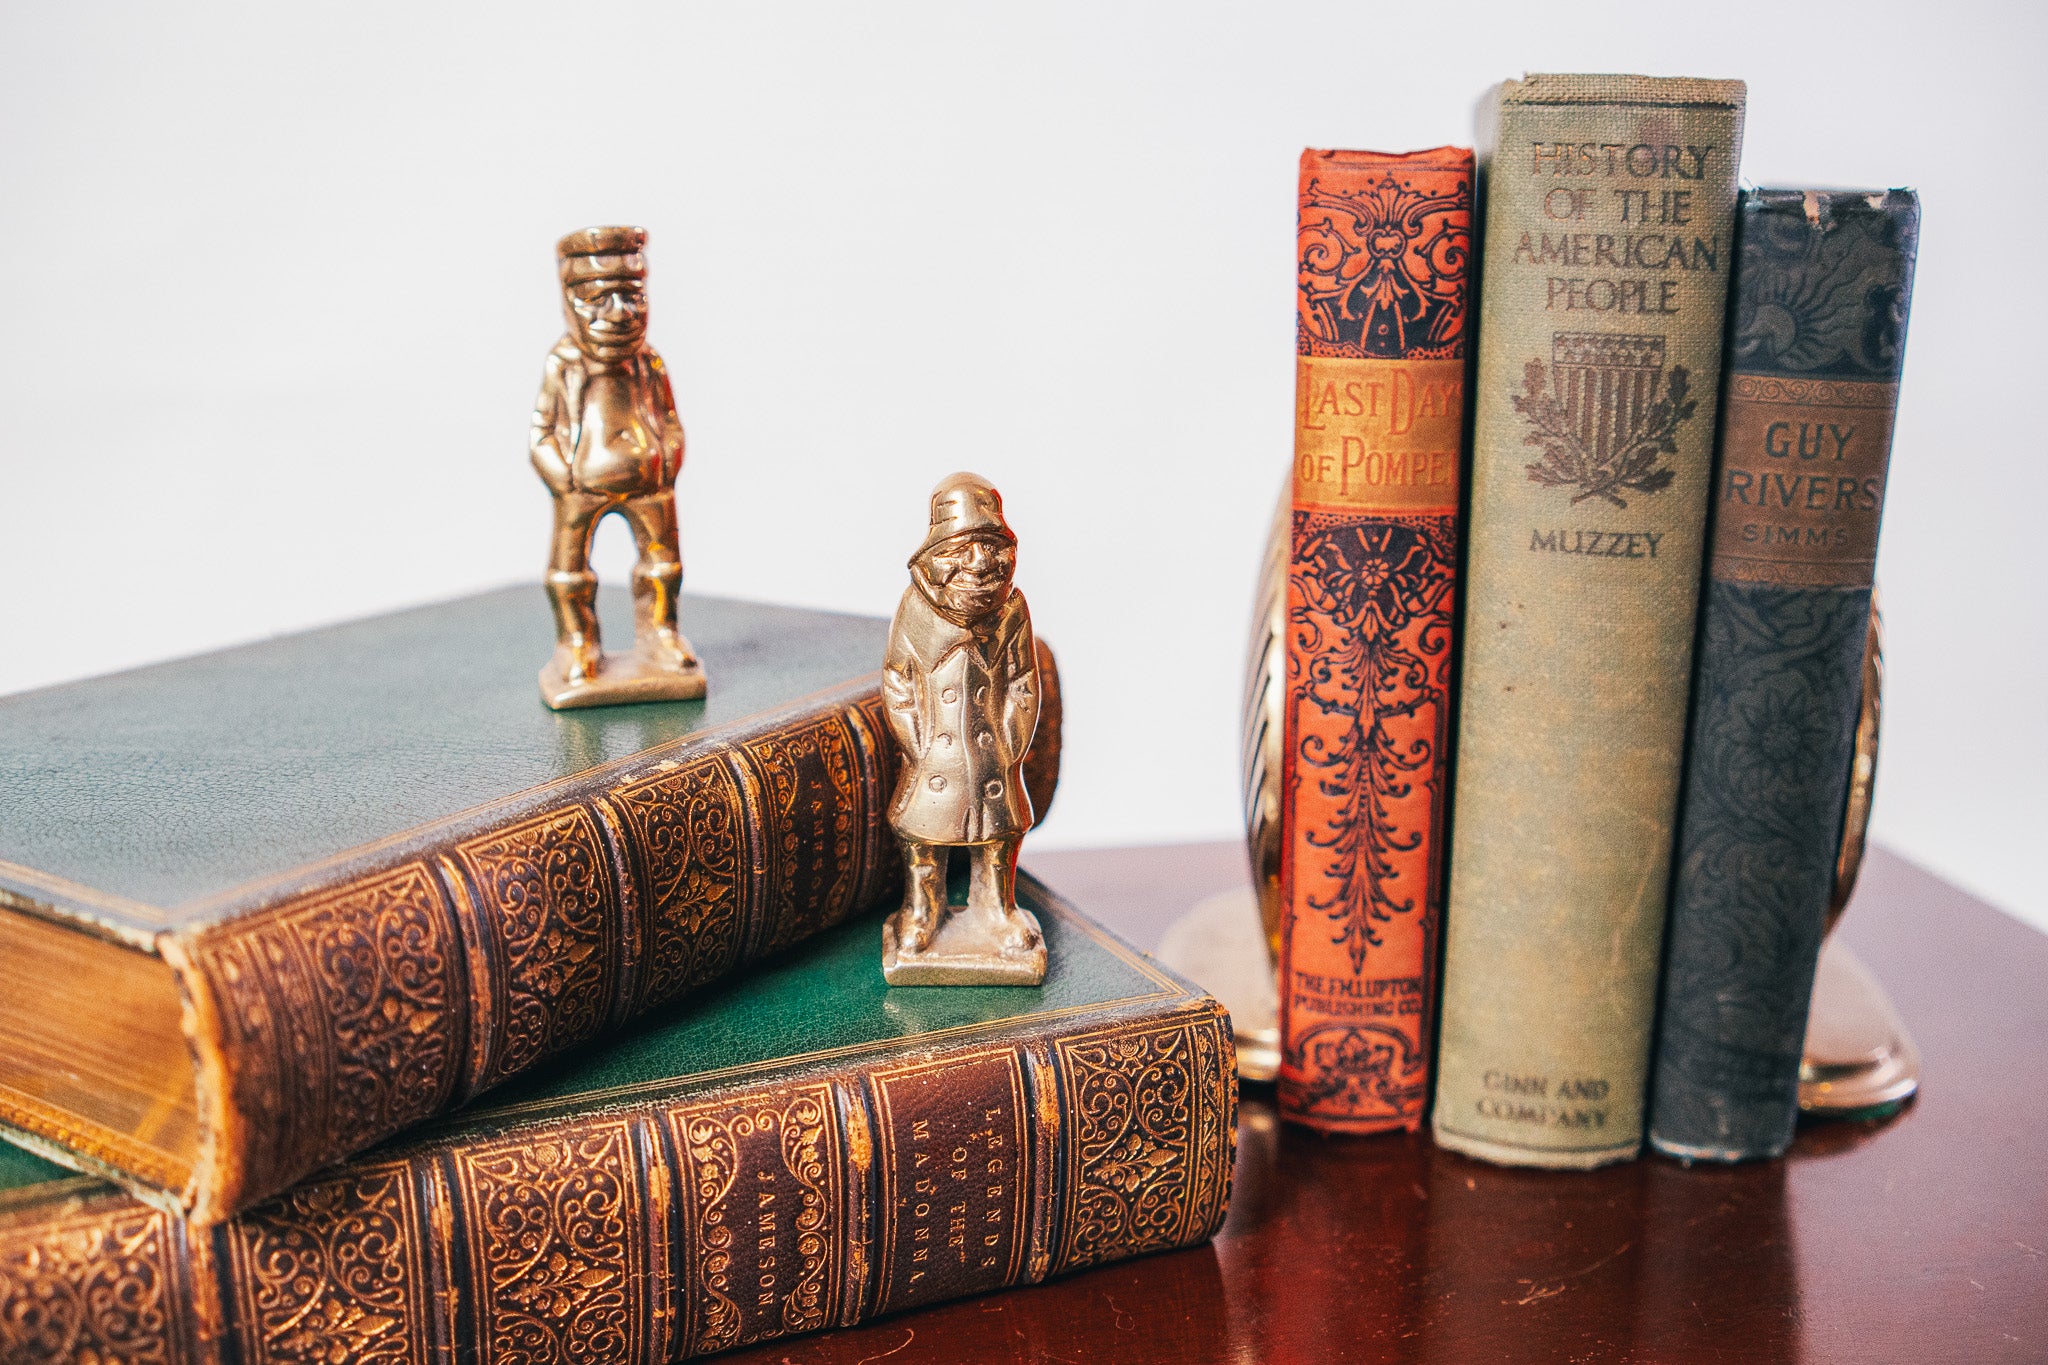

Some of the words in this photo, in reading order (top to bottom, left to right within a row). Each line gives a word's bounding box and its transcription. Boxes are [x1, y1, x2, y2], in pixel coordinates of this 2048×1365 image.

[1531, 141, 1713, 180] HISTORY
[1544, 187, 1597, 222] OF
[1614, 189, 1693, 226] THE
[1511, 231, 1718, 272] AMERICAN
[1545, 277, 1681, 315] PEOPLE
[1302, 363, 1385, 431] LAST
[1765, 421, 1856, 461] GUY
[1300, 453, 1335, 483] OF
[1725, 469, 1878, 512] RIVERS
[1529, 529, 1665, 558] MUZZEY
[1742, 523, 1849, 547] SIMMS
[1482, 1070, 1548, 1098] GINN
[1558, 1079, 1610, 1101] AND
[1476, 1097, 1609, 1129] COMPANY
[951, 1146, 967, 1180] OF
[981, 1108, 1003, 1267] LEGENDS
[949, 1201, 966, 1247] THE
